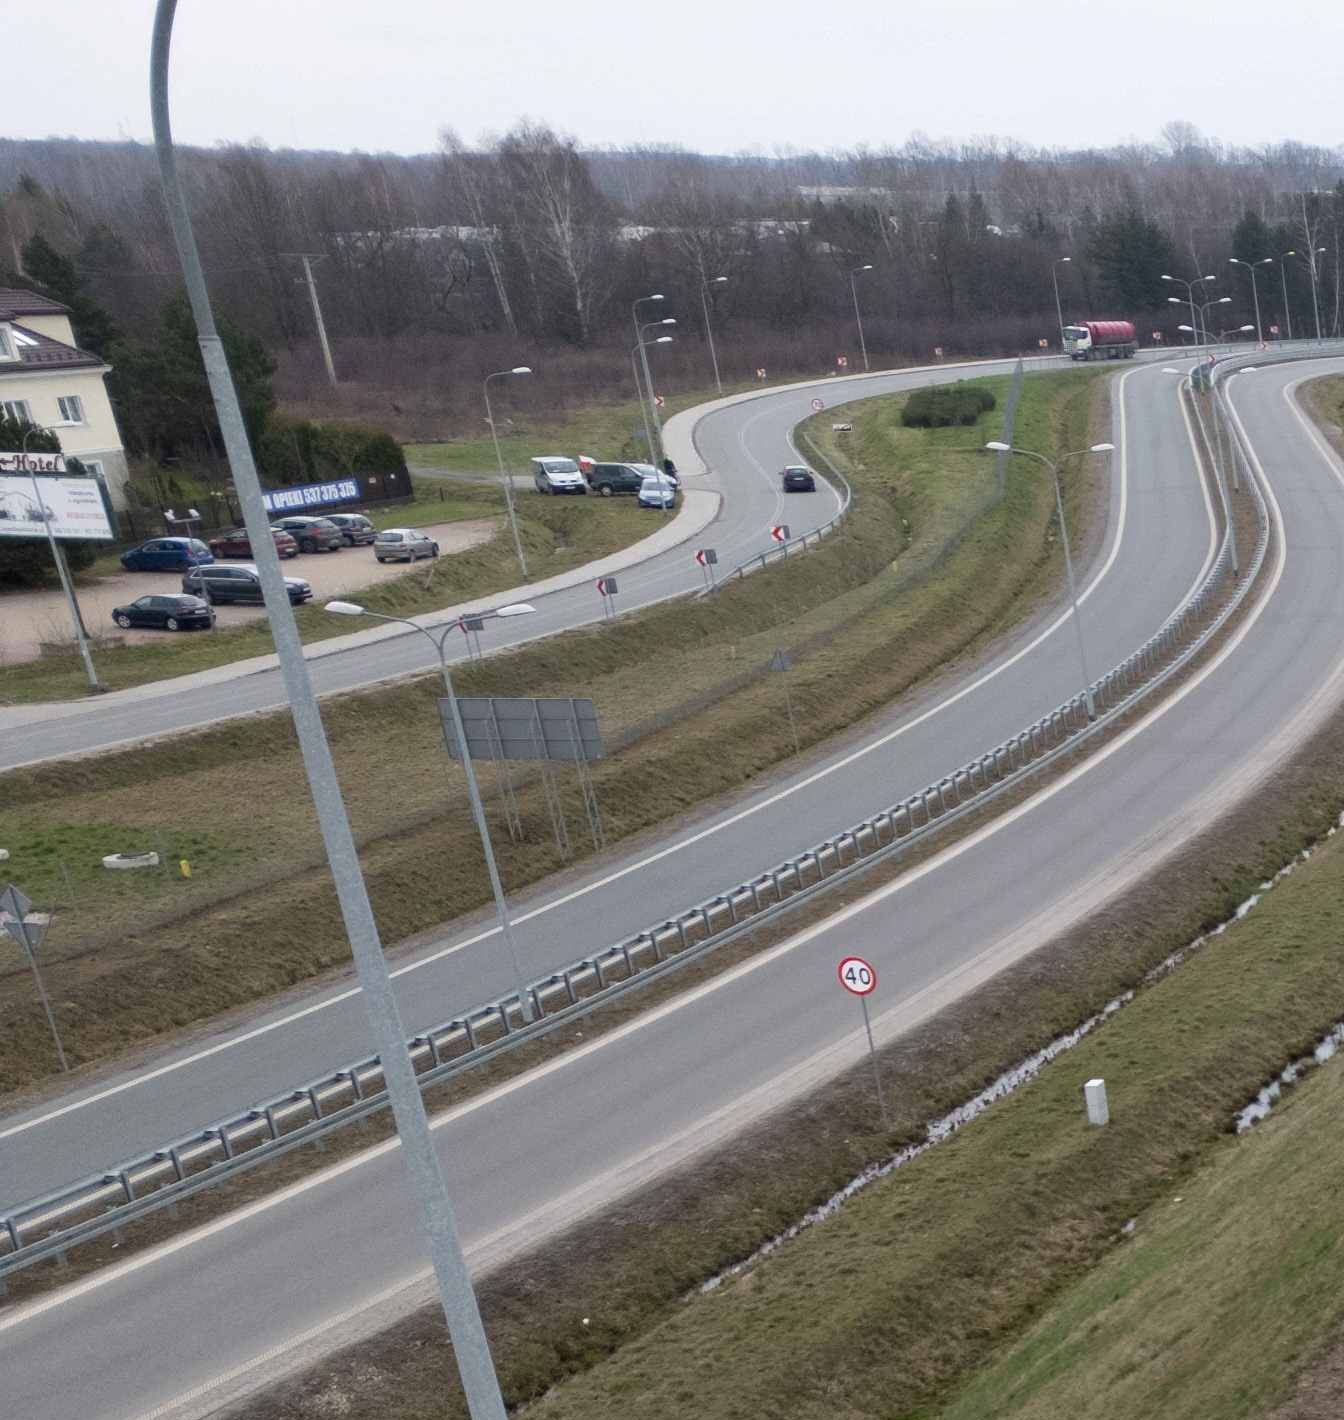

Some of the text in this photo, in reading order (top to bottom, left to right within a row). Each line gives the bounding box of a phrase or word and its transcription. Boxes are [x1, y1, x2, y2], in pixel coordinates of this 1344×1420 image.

[303, 486, 321, 504] 537
[321, 484, 339, 501] 375
[338, 481, 356, 498] 375
[845, 967, 870, 985] 40
